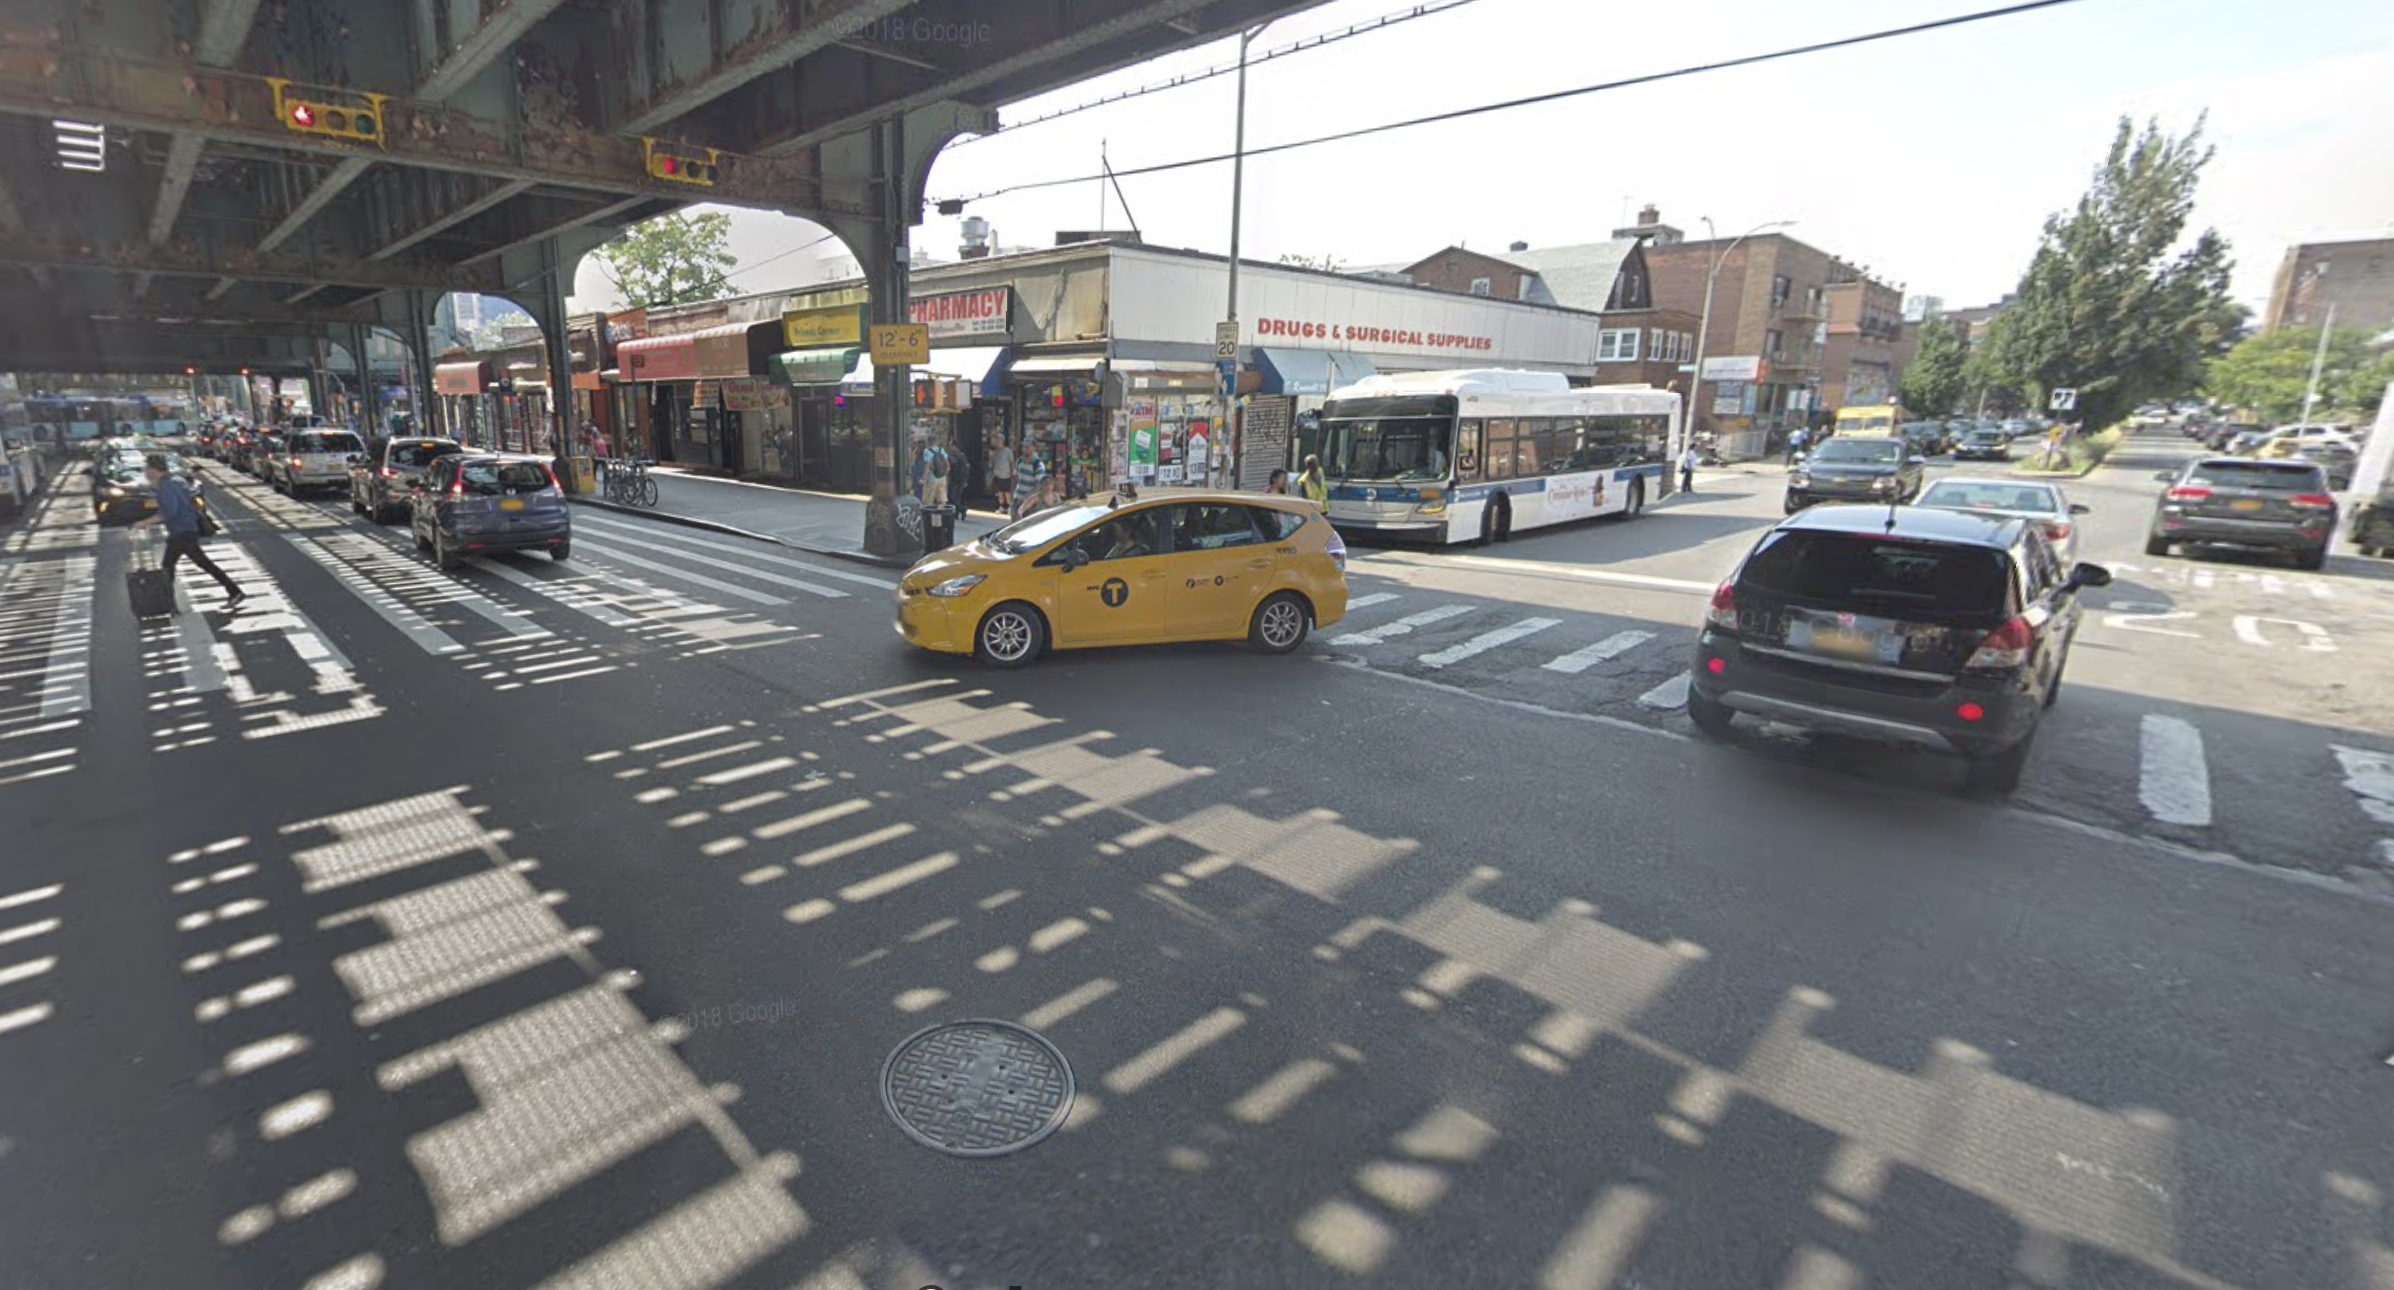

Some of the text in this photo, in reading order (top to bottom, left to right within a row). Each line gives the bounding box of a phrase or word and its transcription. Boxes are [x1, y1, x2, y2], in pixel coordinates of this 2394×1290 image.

[908, 290, 1006, 323] PHARMACY
[1258, 317, 1492, 350] DRUGS & SURGICAL SUPPLIES
[1218, 341, 1235, 356] 20
[1105, 581, 1124, 605] T
